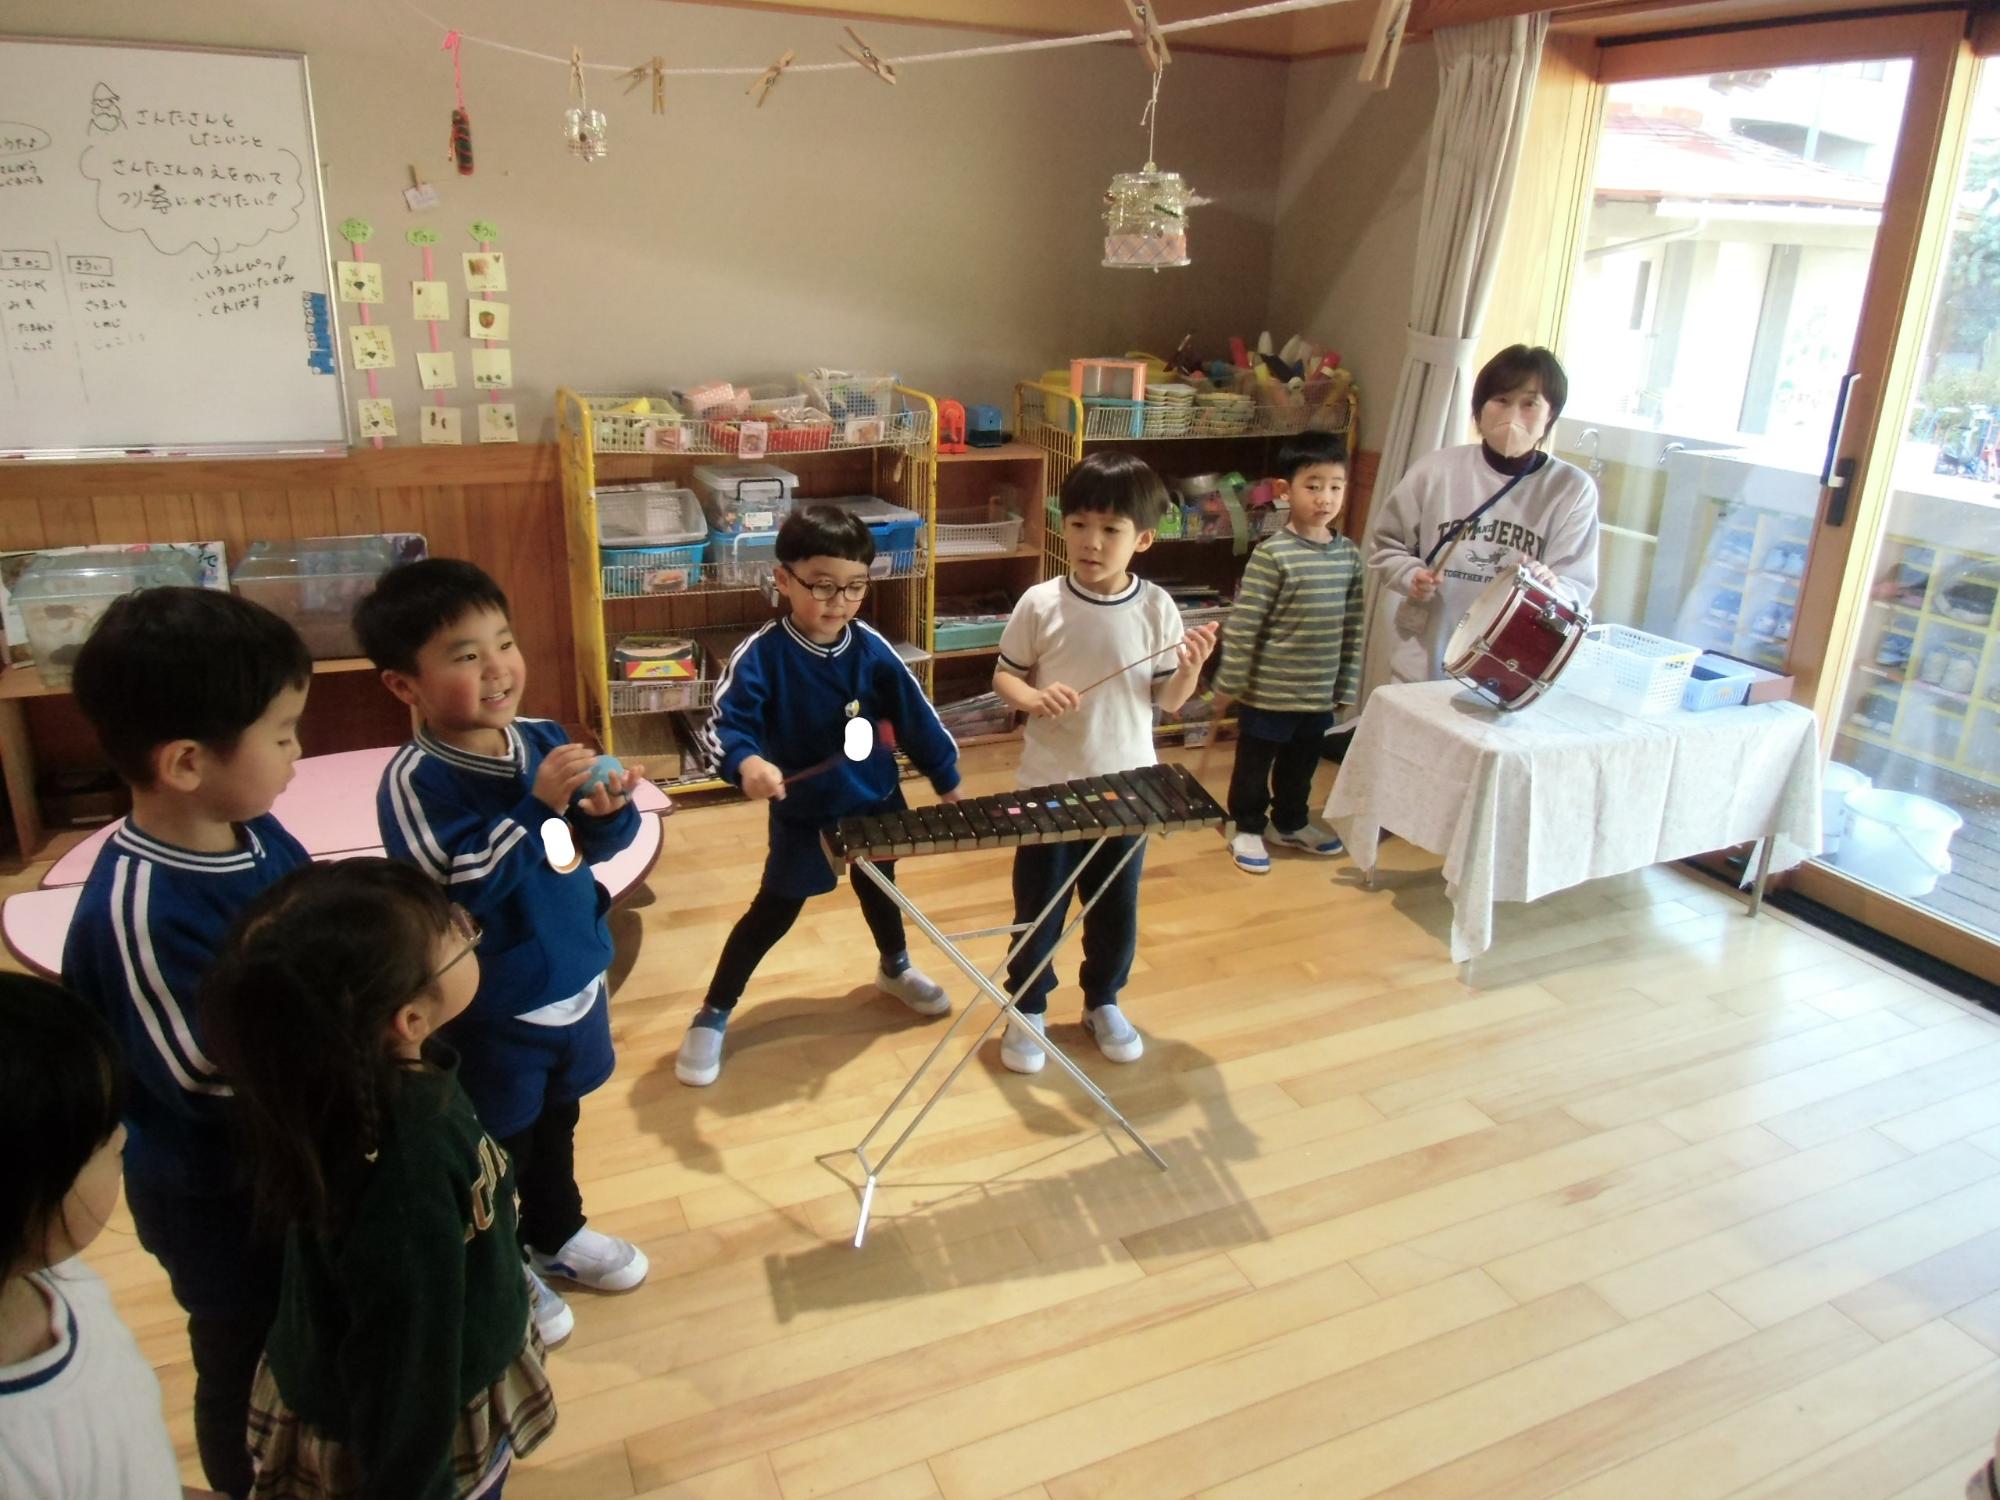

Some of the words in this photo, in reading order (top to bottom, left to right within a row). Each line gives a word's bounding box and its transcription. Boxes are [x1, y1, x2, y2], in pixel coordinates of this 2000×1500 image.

[190, 132, 263, 148] したいこと
[1443, 569, 1482, 583] TOGETHER
